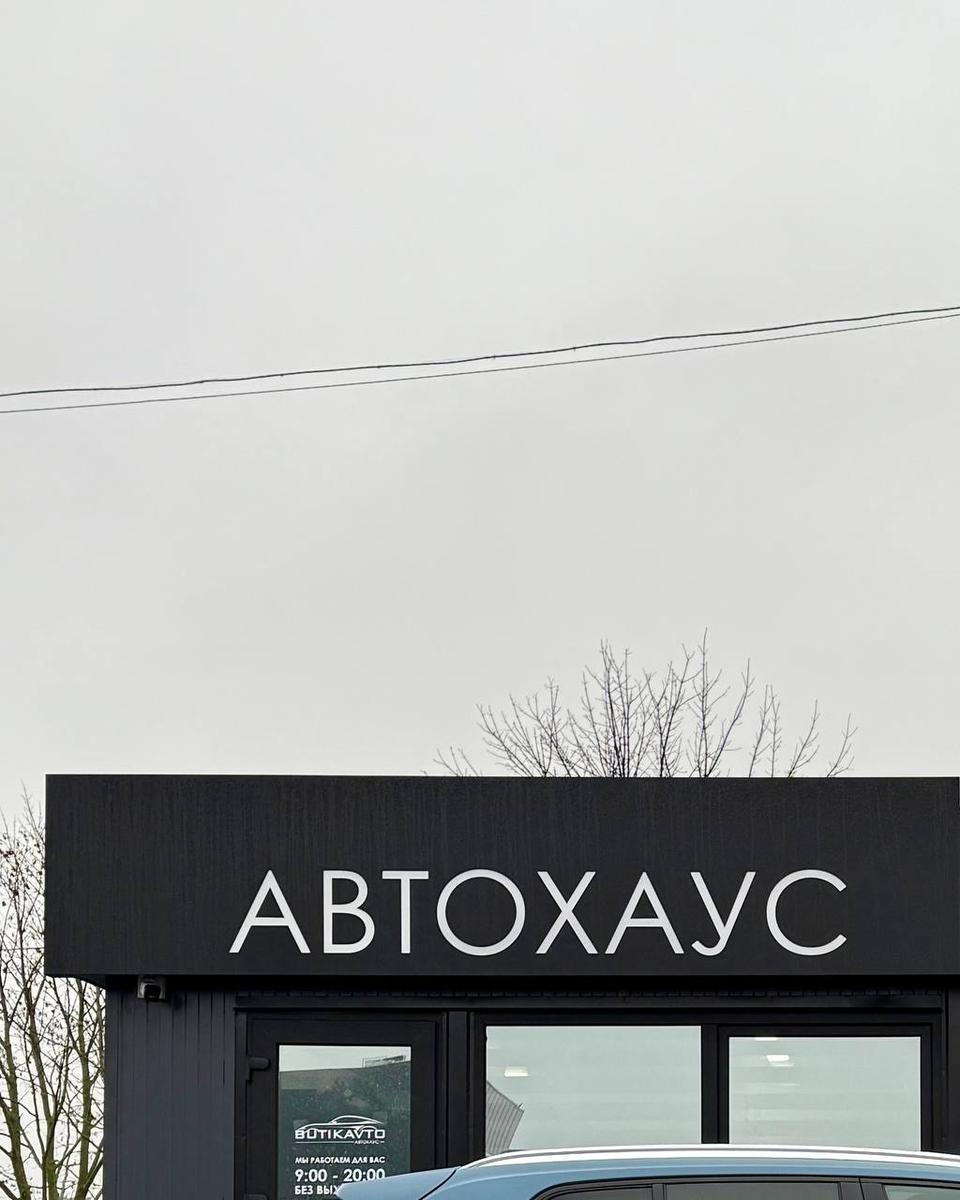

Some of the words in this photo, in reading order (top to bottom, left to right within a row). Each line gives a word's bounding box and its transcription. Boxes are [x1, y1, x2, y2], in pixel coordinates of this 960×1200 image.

[229, 868, 847, 956] АВТОХАУС
[294, 1129, 386, 1139] BUTIKAVTO
[310, 1156, 350, 1164] РАБОТАЕМ
[369, 1156, 386, 1164] ВАС
[294, 1169, 327, 1182] 9:00
[343, 1169, 386, 1182] 20:00
[294, 1185, 314, 1195] БЕЗ
